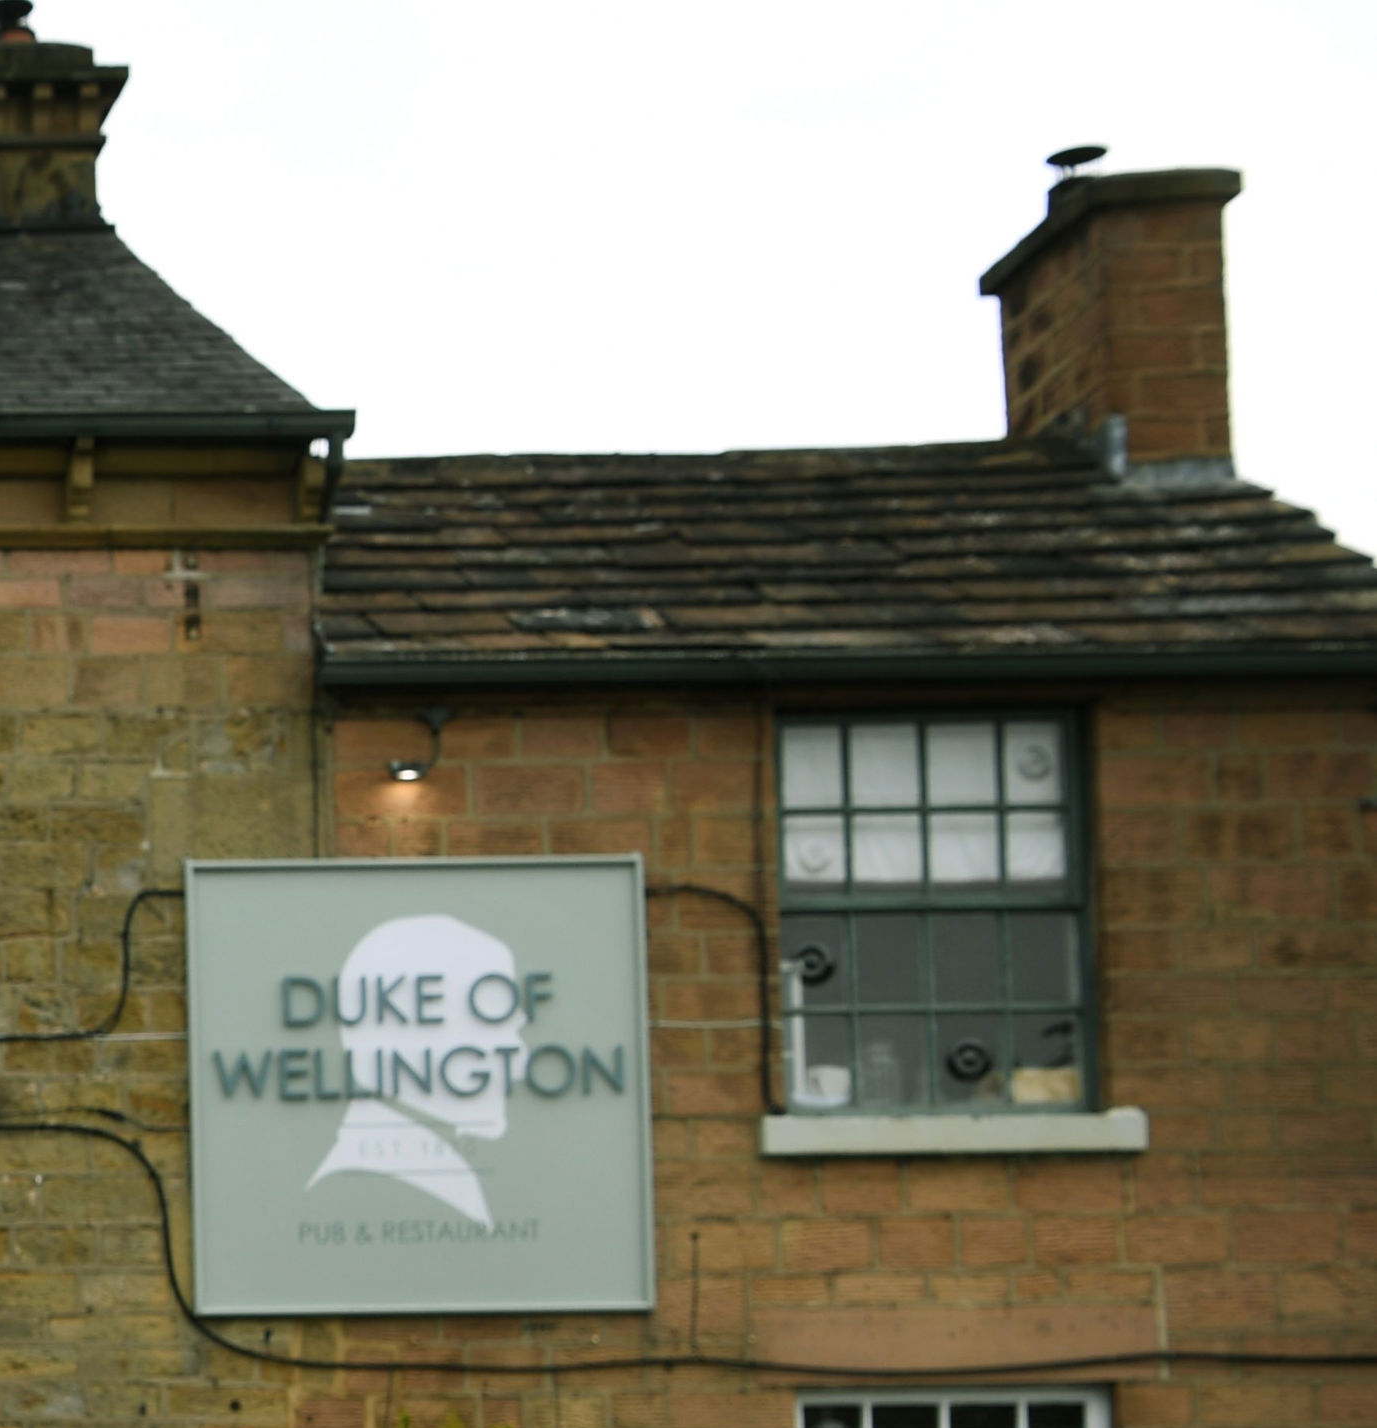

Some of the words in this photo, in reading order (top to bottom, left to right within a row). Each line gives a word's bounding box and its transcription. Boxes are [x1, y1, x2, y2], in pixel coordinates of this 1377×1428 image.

[280, 974, 445, 1030] DUKE
[466, 972, 553, 1024] OF
[212, 1043, 625, 1103] WELLINGTON
[298, 1222, 347, 1244] PUB
[355, 1222, 373, 1242] &
[383, 1218, 540, 1243] RESTAURANT
